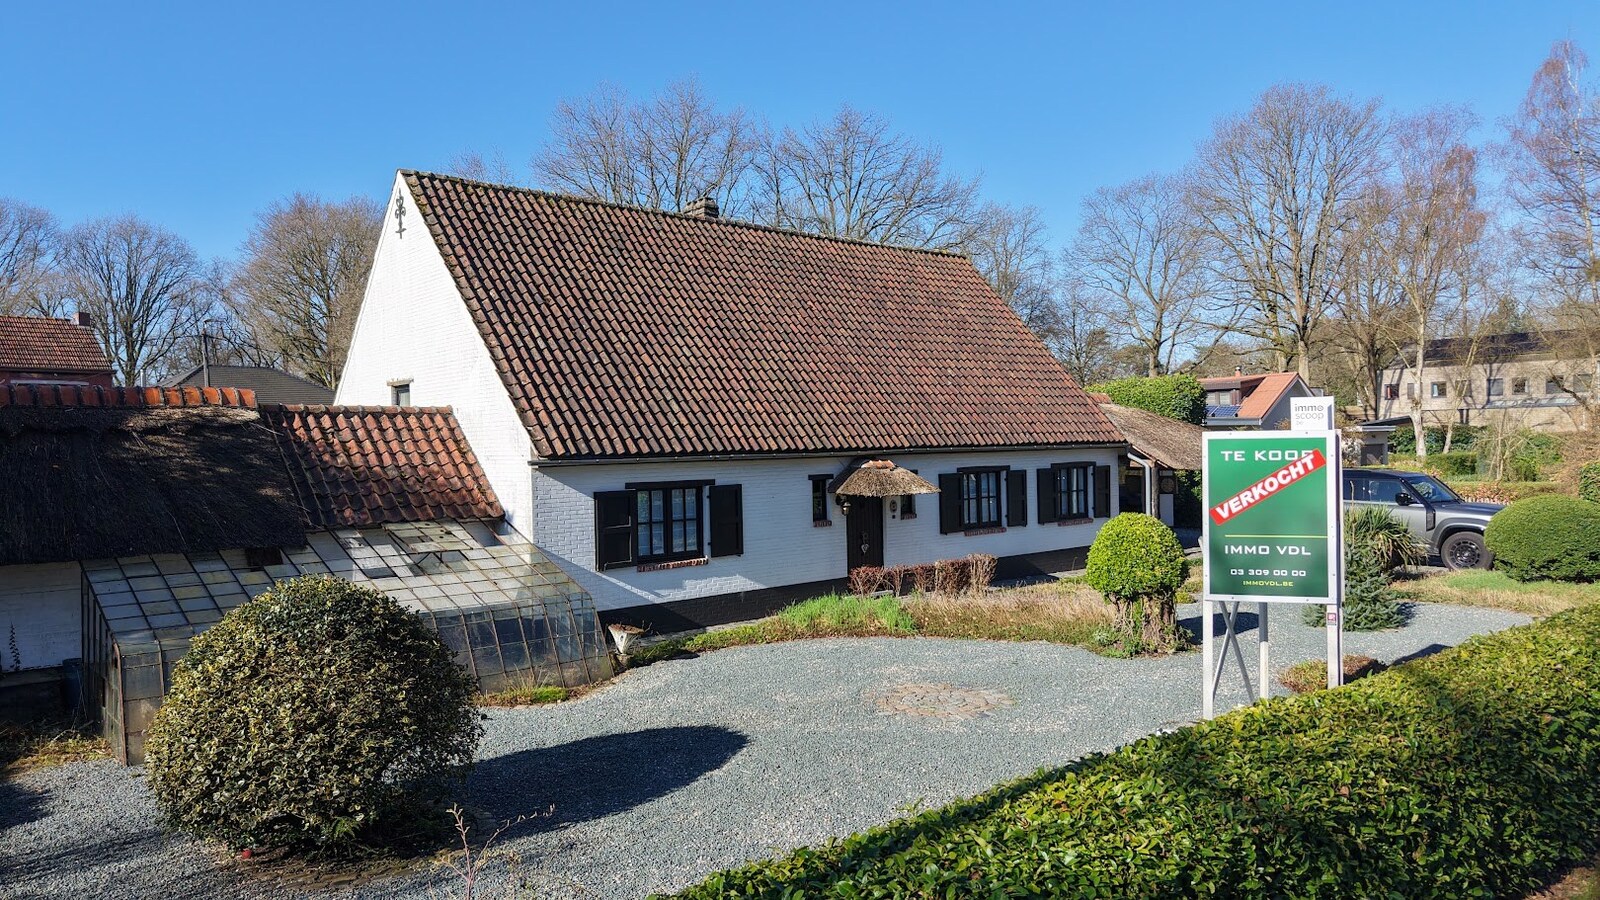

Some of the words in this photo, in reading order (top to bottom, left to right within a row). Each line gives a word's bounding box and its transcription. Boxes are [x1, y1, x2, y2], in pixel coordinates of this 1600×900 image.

[1294, 404, 1324, 412] immo
[1220, 450, 1246, 461] TE
[1216, 454, 1314, 519] VERKOCHT
[1224, 545, 1270, 554] IMMO
[1276, 546, 1311, 555] VDL
